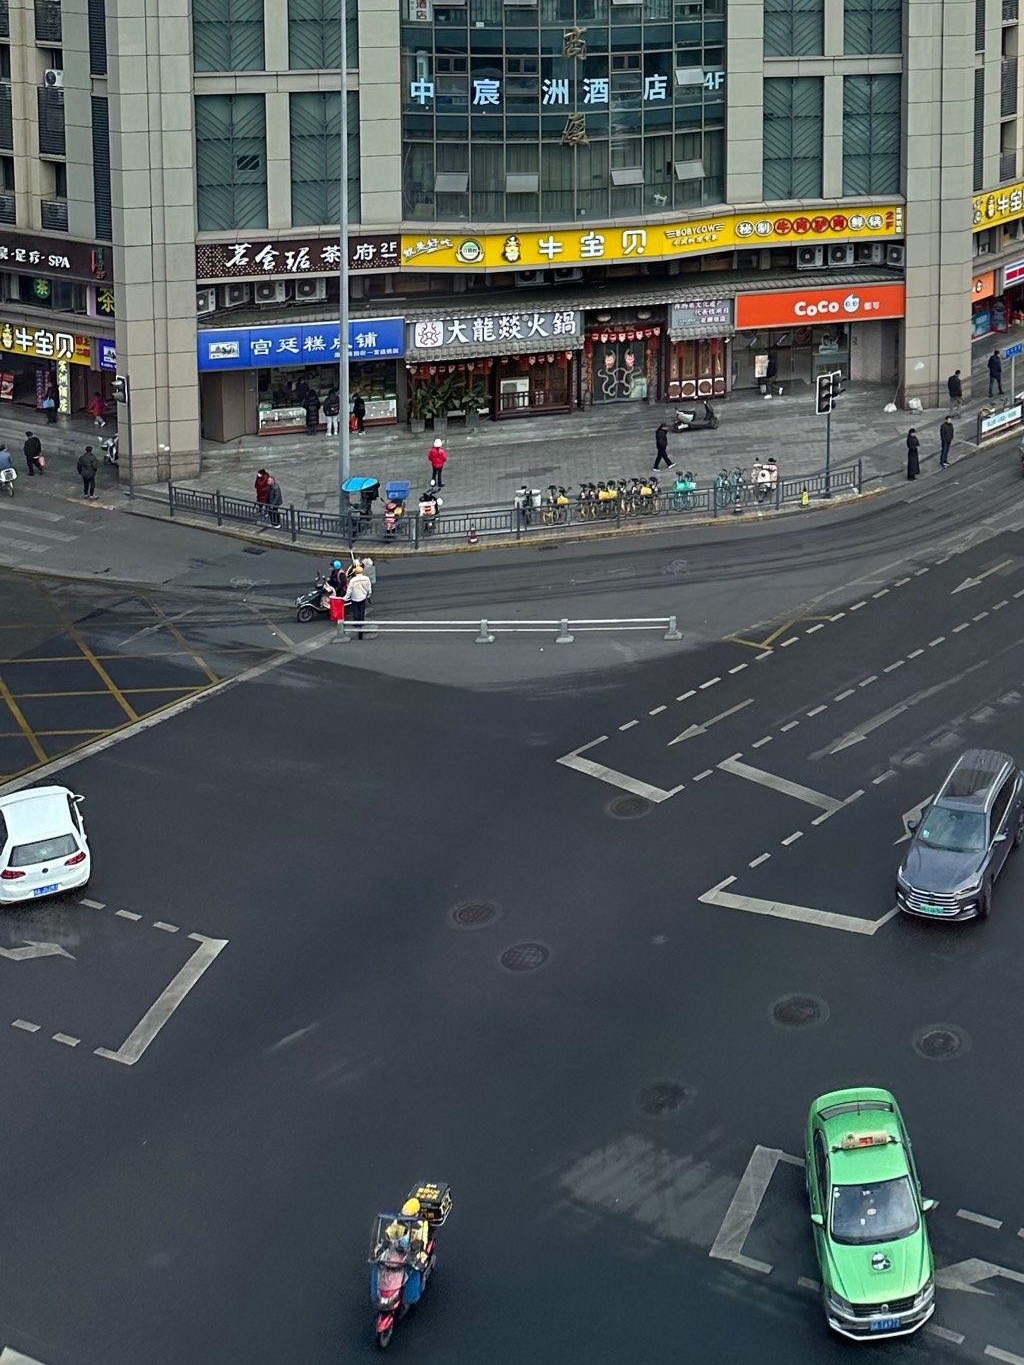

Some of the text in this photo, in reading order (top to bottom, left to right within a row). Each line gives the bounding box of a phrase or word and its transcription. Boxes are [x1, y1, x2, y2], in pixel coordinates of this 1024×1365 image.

[380, 241, 397, 253] 2F
[537, 229, 647, 260] 牛宝贝
[794, 300, 840, 316] CoCo
[15, 327, 74, 359] 牛宝贝
[446, 311, 576, 344] 大龍燚火鍋
